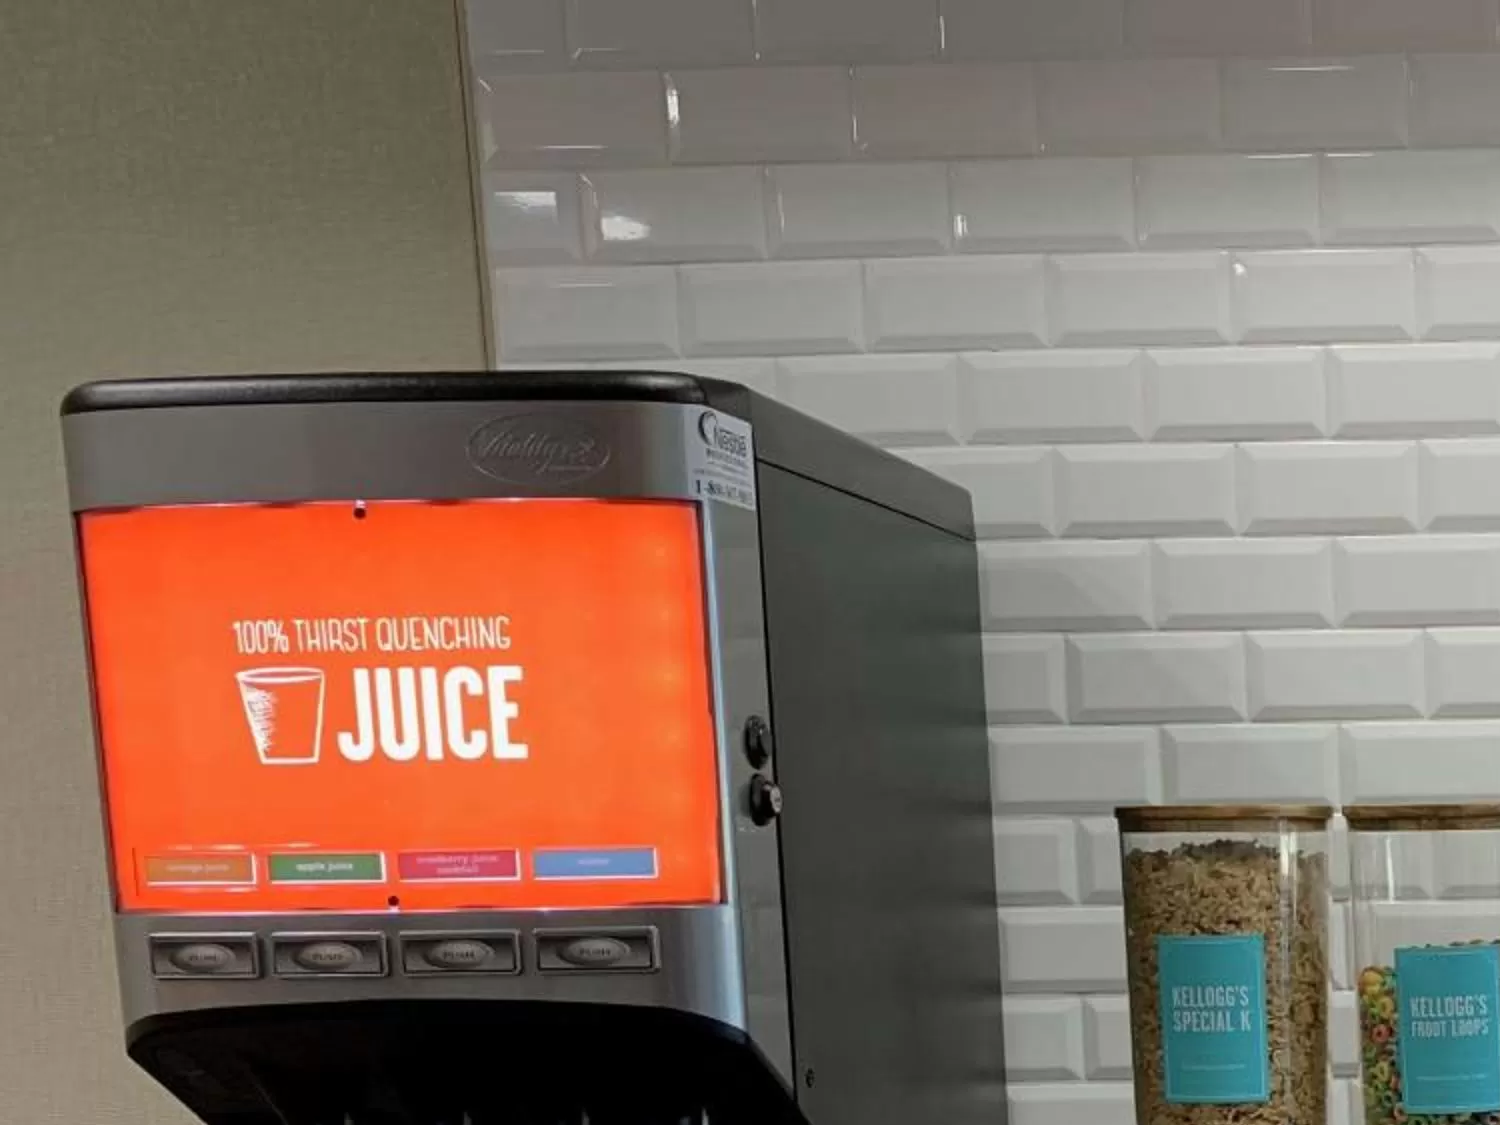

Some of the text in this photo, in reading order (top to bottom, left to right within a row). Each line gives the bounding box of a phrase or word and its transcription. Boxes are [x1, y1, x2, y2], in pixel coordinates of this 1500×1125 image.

[232, 615, 511, 653] 100% THIRST QUENCHING
[337, 664, 529, 762] JUICE
[1172, 985, 1249, 1008] KELLOGG'S
[1410, 994, 1488, 1018] KELLOGG'S
[1173, 1010, 1252, 1033] SPECIAL K
[1411, 1017, 1489, 1038] FROOT LOOPS
